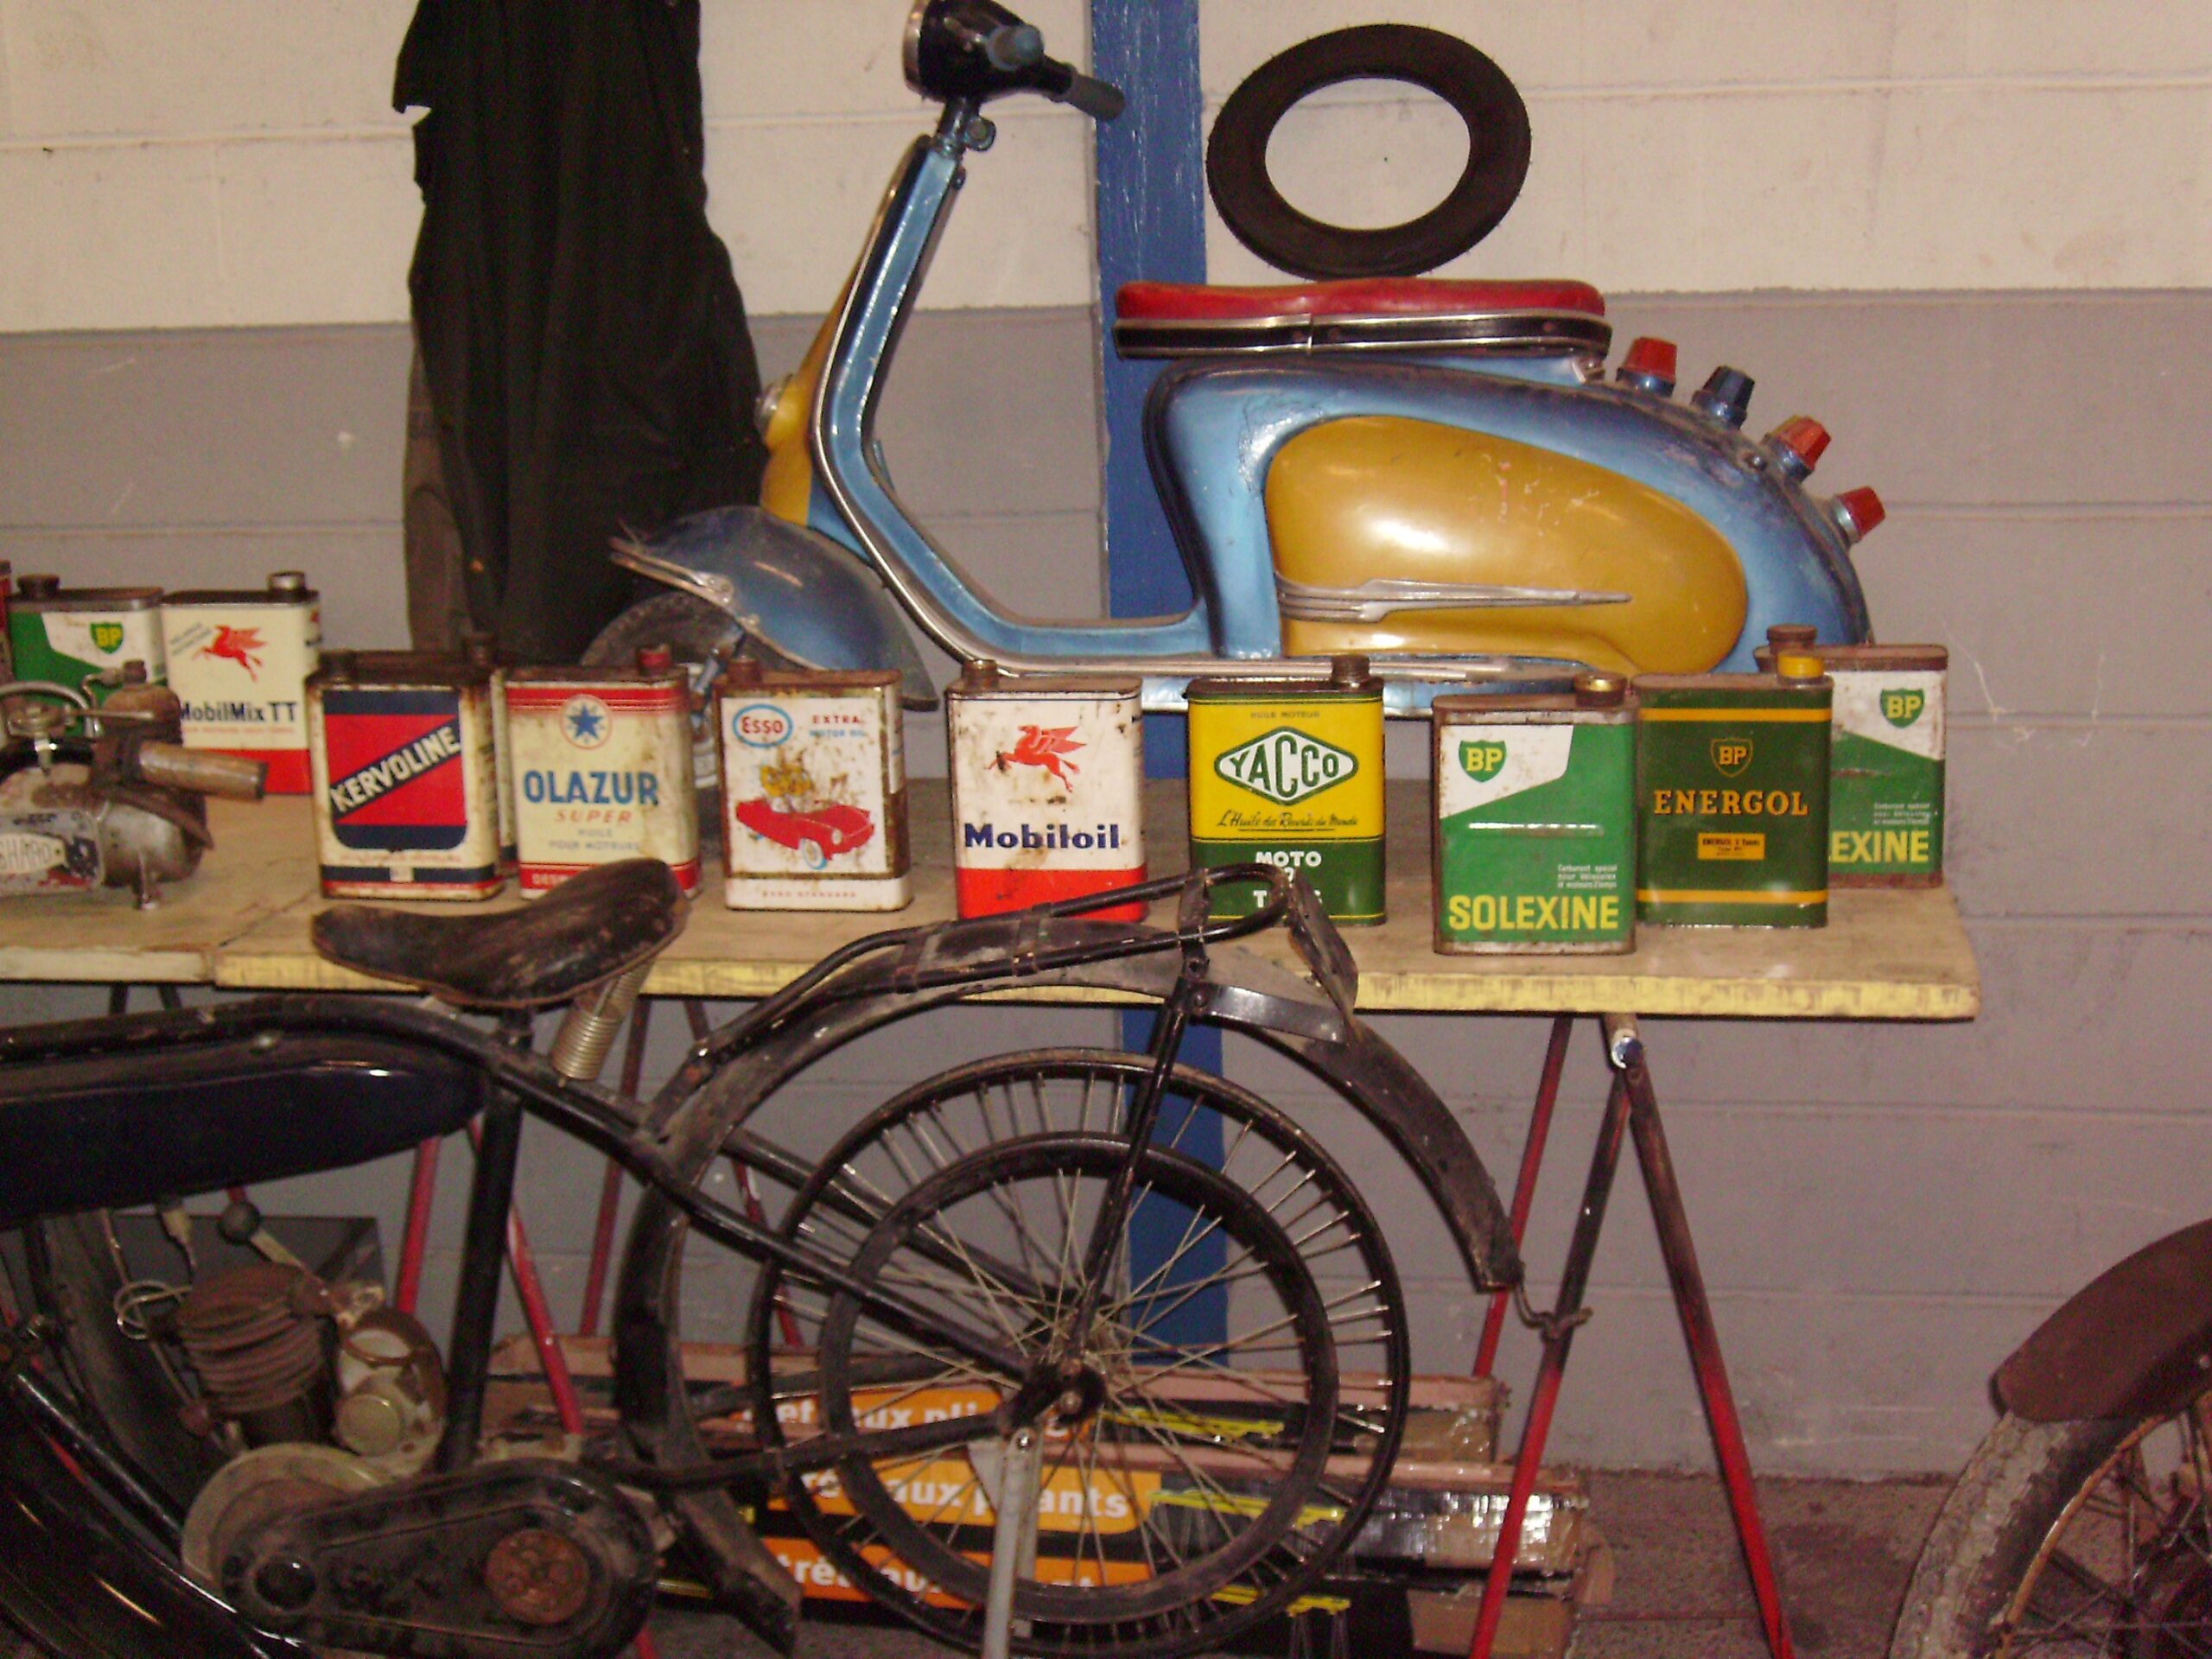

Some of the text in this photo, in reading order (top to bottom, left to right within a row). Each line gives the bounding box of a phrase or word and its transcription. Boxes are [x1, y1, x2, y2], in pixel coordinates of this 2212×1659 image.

[96, 626, 121, 647] BP
[268, 701, 297, 722] TT
[811, 715, 861, 724] EXTRA
[1885, 697, 1922, 718] BP
[1229, 734, 1340, 798] YACCO
[1465, 747, 1503, 772] BP
[1719, 745, 1748, 766] BP
[330, 726, 461, 813] KERVOLINE
[524, 770, 660, 807] OLAZUR
[1653, 790, 1808, 816] ENERGOL
[556, 809, 633, 823] SUPER
[964, 823, 1120, 849] Mobiloil
[1829, 830, 1929, 862] EXINE
[1255, 851, 1322, 867] MOTO
[1448, 894, 1619, 930] SOLEXINE
